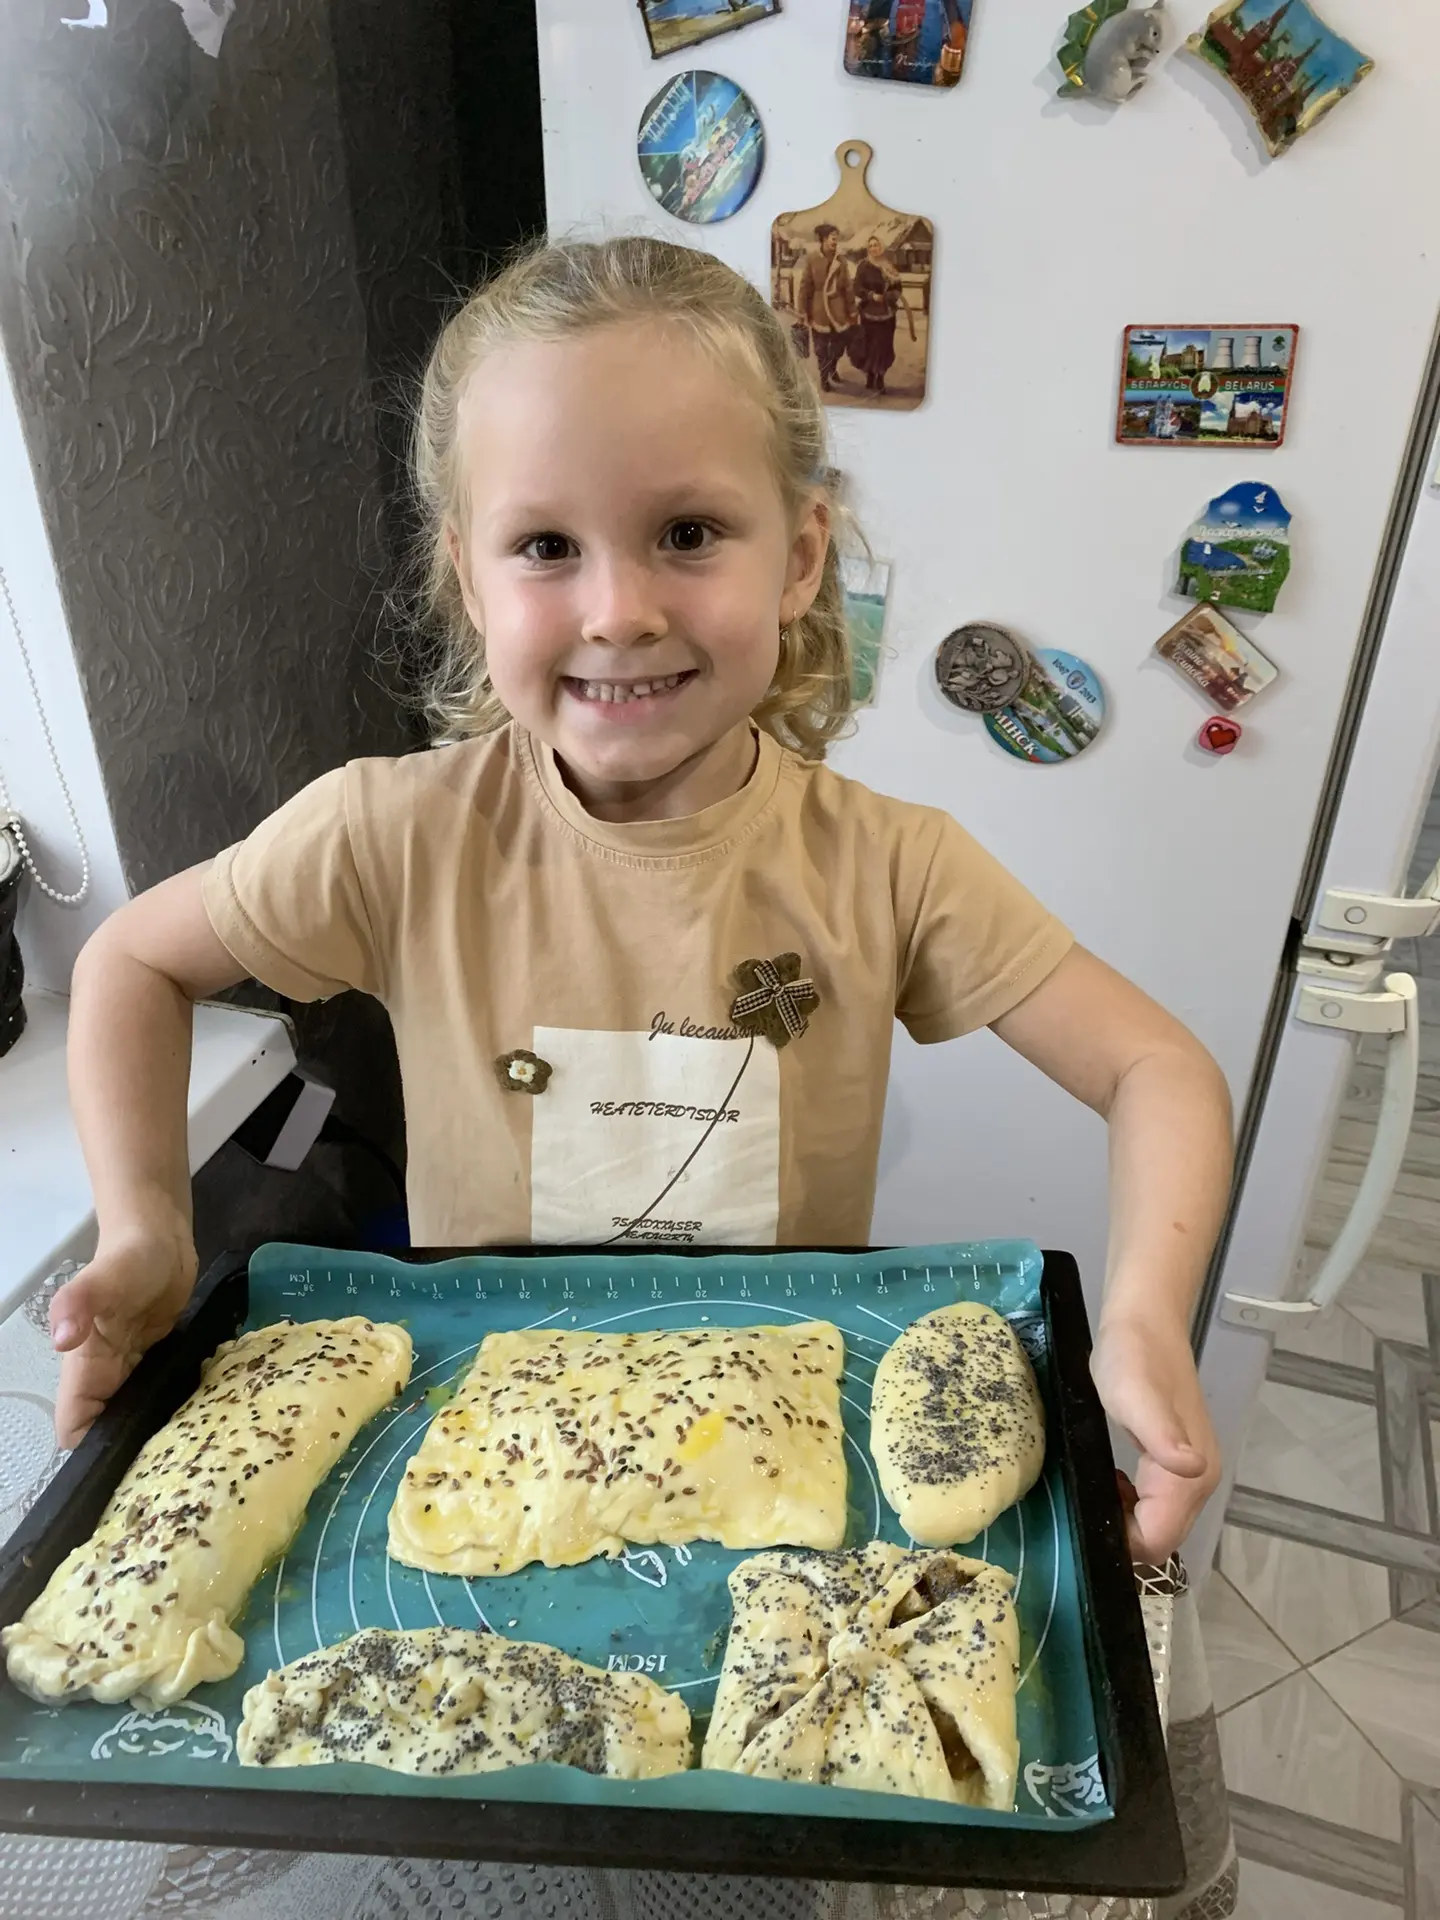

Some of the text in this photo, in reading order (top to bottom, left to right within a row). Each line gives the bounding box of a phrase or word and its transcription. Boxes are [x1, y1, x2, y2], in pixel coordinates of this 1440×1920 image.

[1225, 380, 1275, 392] BELARUS
[289, 1274, 305, 1283] CM
[876, 1285, 889, 1294] 12
[923, 1284, 935, 1293] 10
[973, 1280, 981, 1290] 8
[346, 1286, 358, 1295] 36
[390, 1288, 402, 1297] 34
[519, 1291, 530, 1299] 28
[562, 1291, 575, 1299] 26
[606, 1291, 619, 1299] 24
[651, 1290, 663, 1299] 22
[695, 1290, 707, 1298] 20
[739, 1289, 752, 1298] 18
[784, 1288, 797, 1297] 16
[831, 1287, 843, 1296] 14
[475, 1291, 487, 1300] 30
[606, 1653, 668, 1673] 15CM
